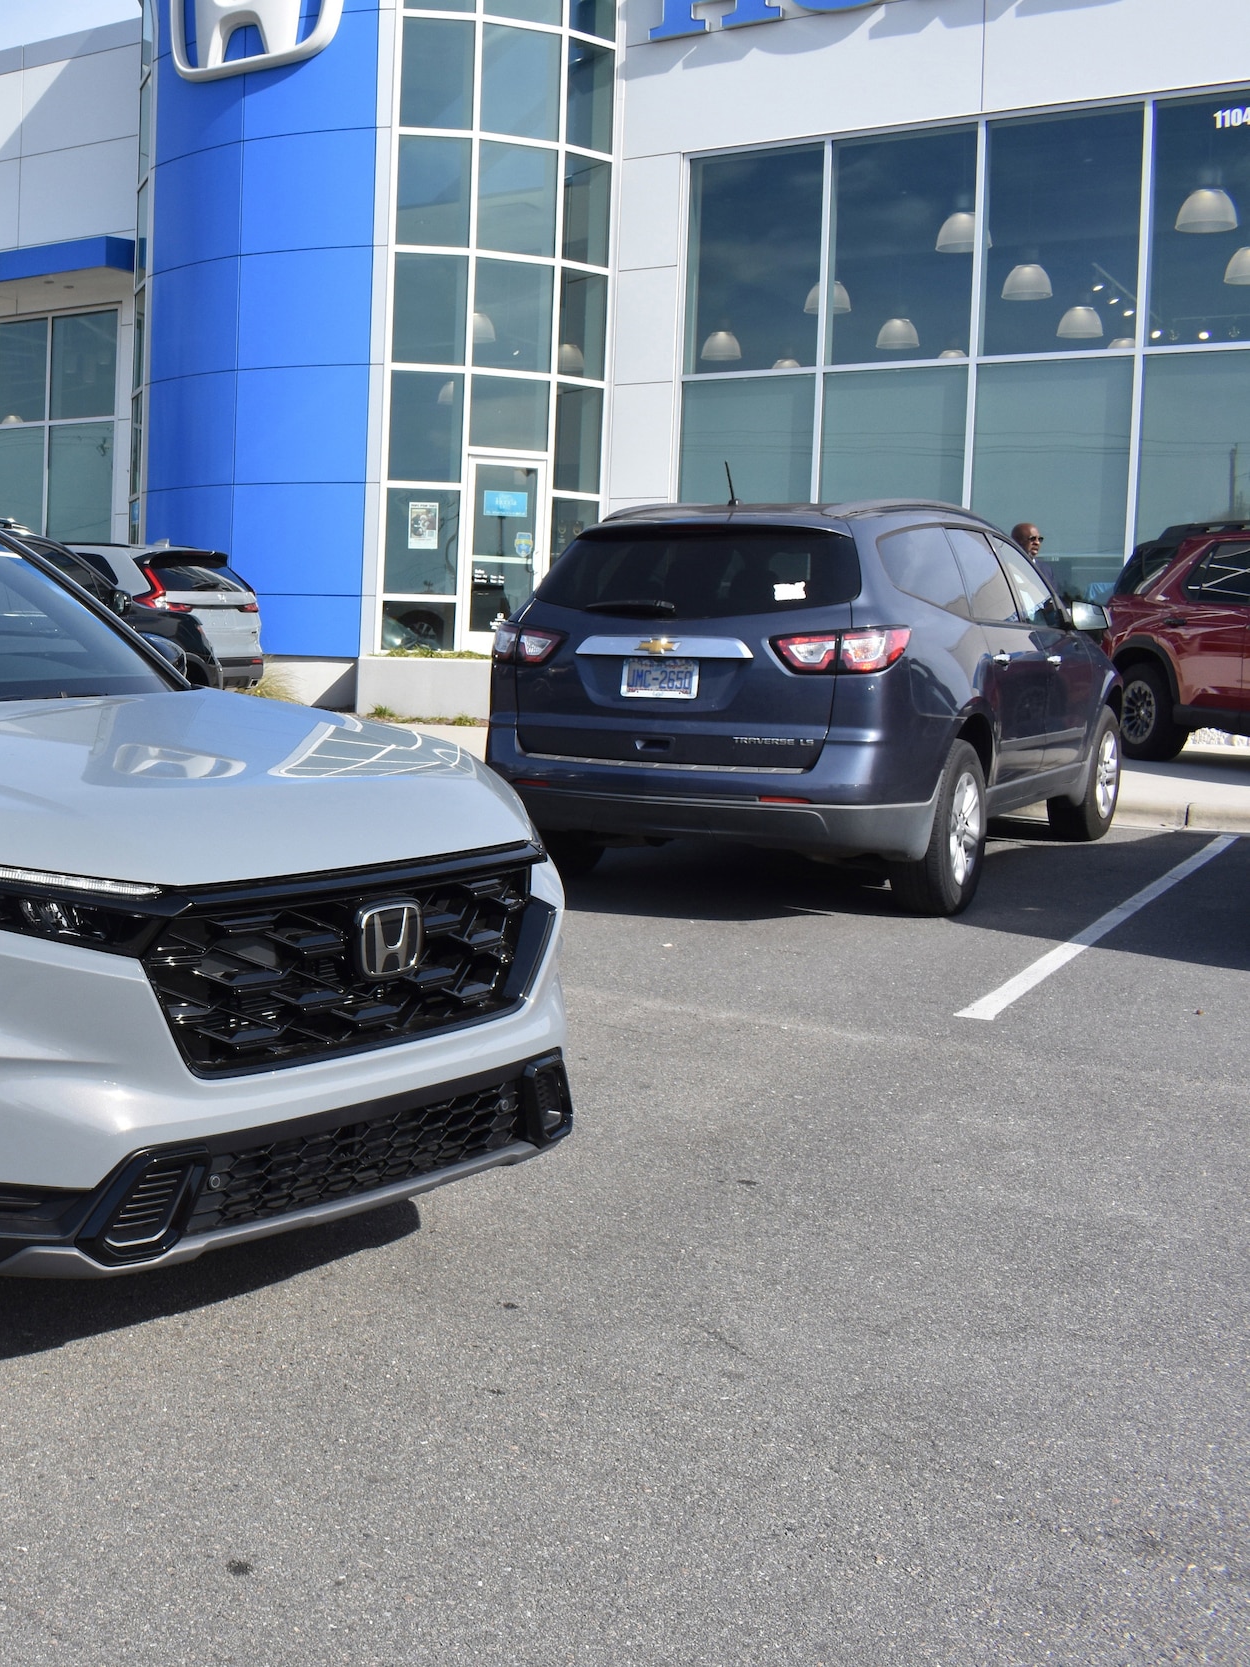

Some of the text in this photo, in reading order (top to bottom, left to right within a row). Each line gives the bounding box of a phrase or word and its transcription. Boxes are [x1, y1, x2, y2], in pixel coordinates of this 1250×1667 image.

[1213, 106, 1250, 129] 1104
[627, 669, 692, 689] JMC-2650
[733, 736, 814, 747] TRAVERSE LS
